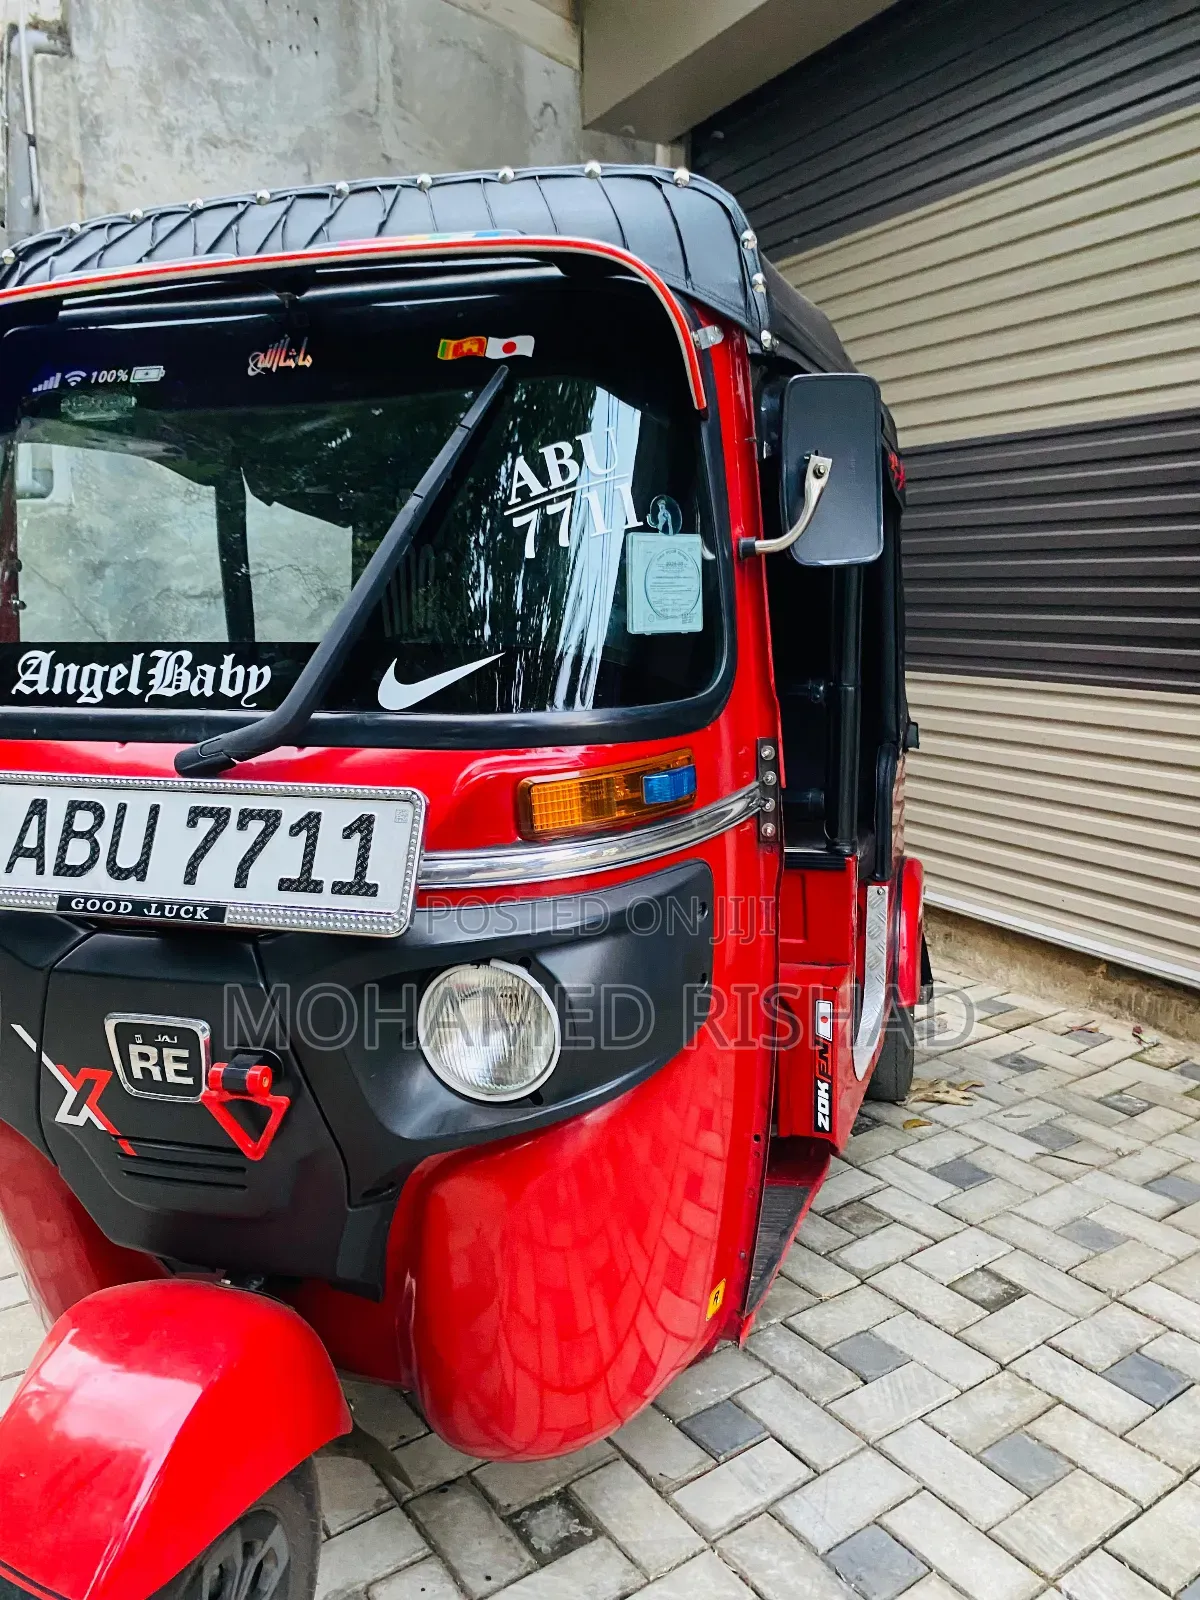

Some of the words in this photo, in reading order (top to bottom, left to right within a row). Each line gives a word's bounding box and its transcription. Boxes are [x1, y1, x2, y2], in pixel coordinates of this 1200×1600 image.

[91, 369, 129, 384] 100%
[508, 427, 618, 505] ABU
[512, 482, 644, 559] 7711
[4, 798, 161, 882] ABU
[183, 805, 381, 898] 7711
[70, 897, 133, 914] GOOD
[148, 903, 210, 920] LUCK
[129, 1043, 194, 1085] RE
